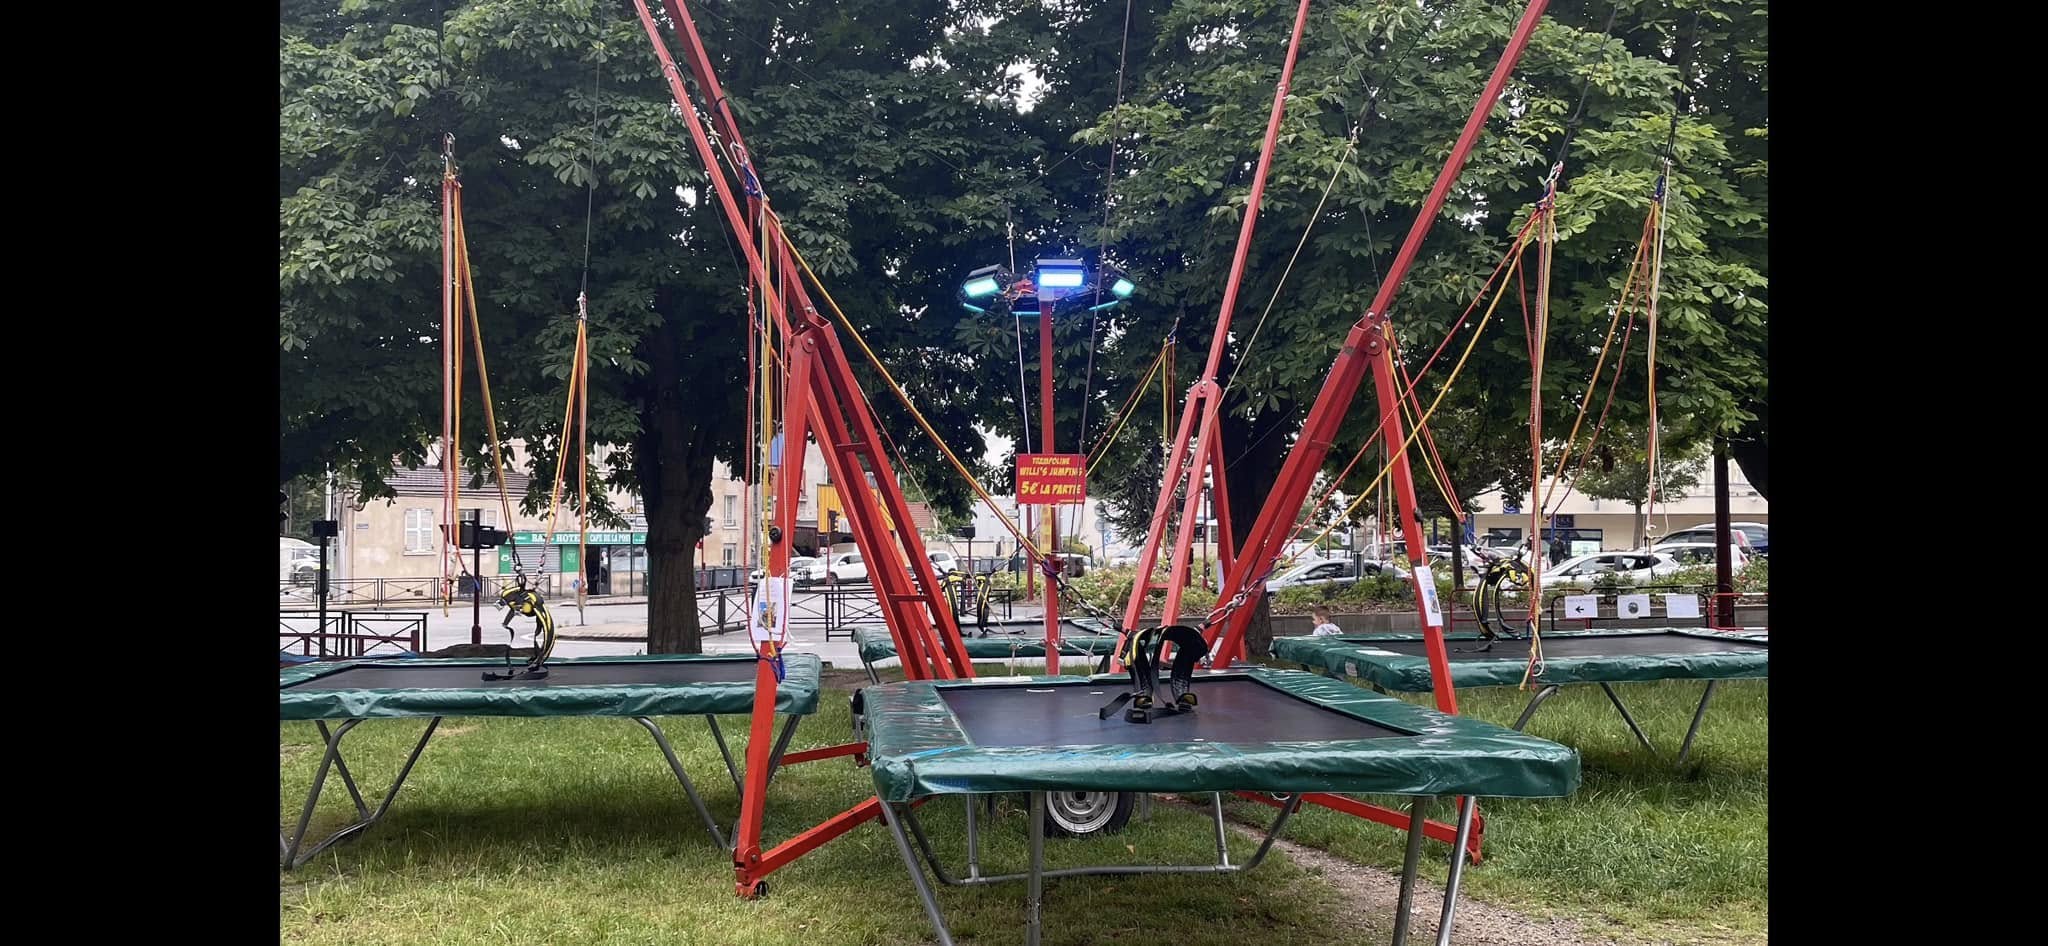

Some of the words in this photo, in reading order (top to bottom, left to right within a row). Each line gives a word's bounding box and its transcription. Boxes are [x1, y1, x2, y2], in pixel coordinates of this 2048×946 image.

[1019, 466, 1048, 477] WILLI'S
[1021, 481, 1040, 495] 5€
[1040, 484, 1051, 495] LA
[1052, 484, 1081, 495] PARTIE
